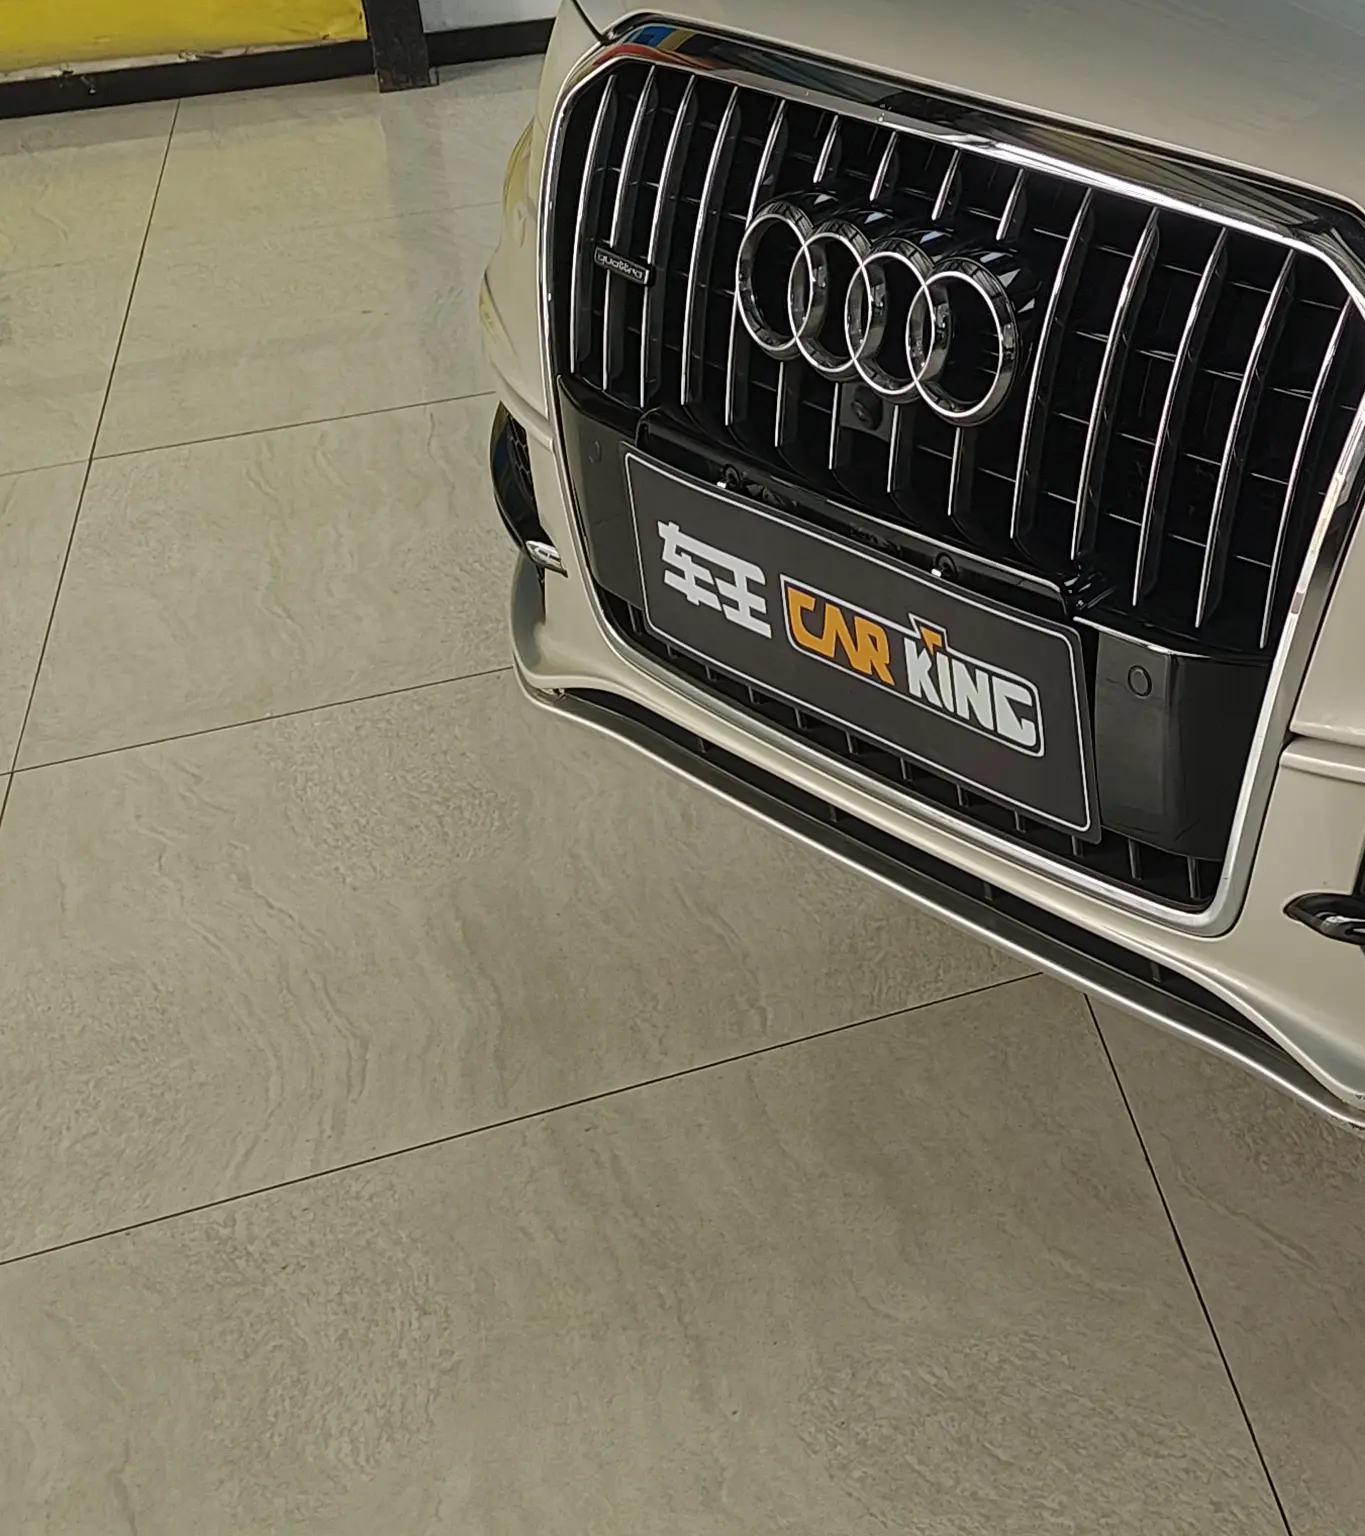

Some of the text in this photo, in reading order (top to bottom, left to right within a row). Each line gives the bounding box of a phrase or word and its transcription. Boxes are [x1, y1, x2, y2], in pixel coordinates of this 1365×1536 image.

[598, 253, 644, 279] quattro
[657, 520, 772, 639] 车王
[787, 586, 1037, 747] CAR KING
